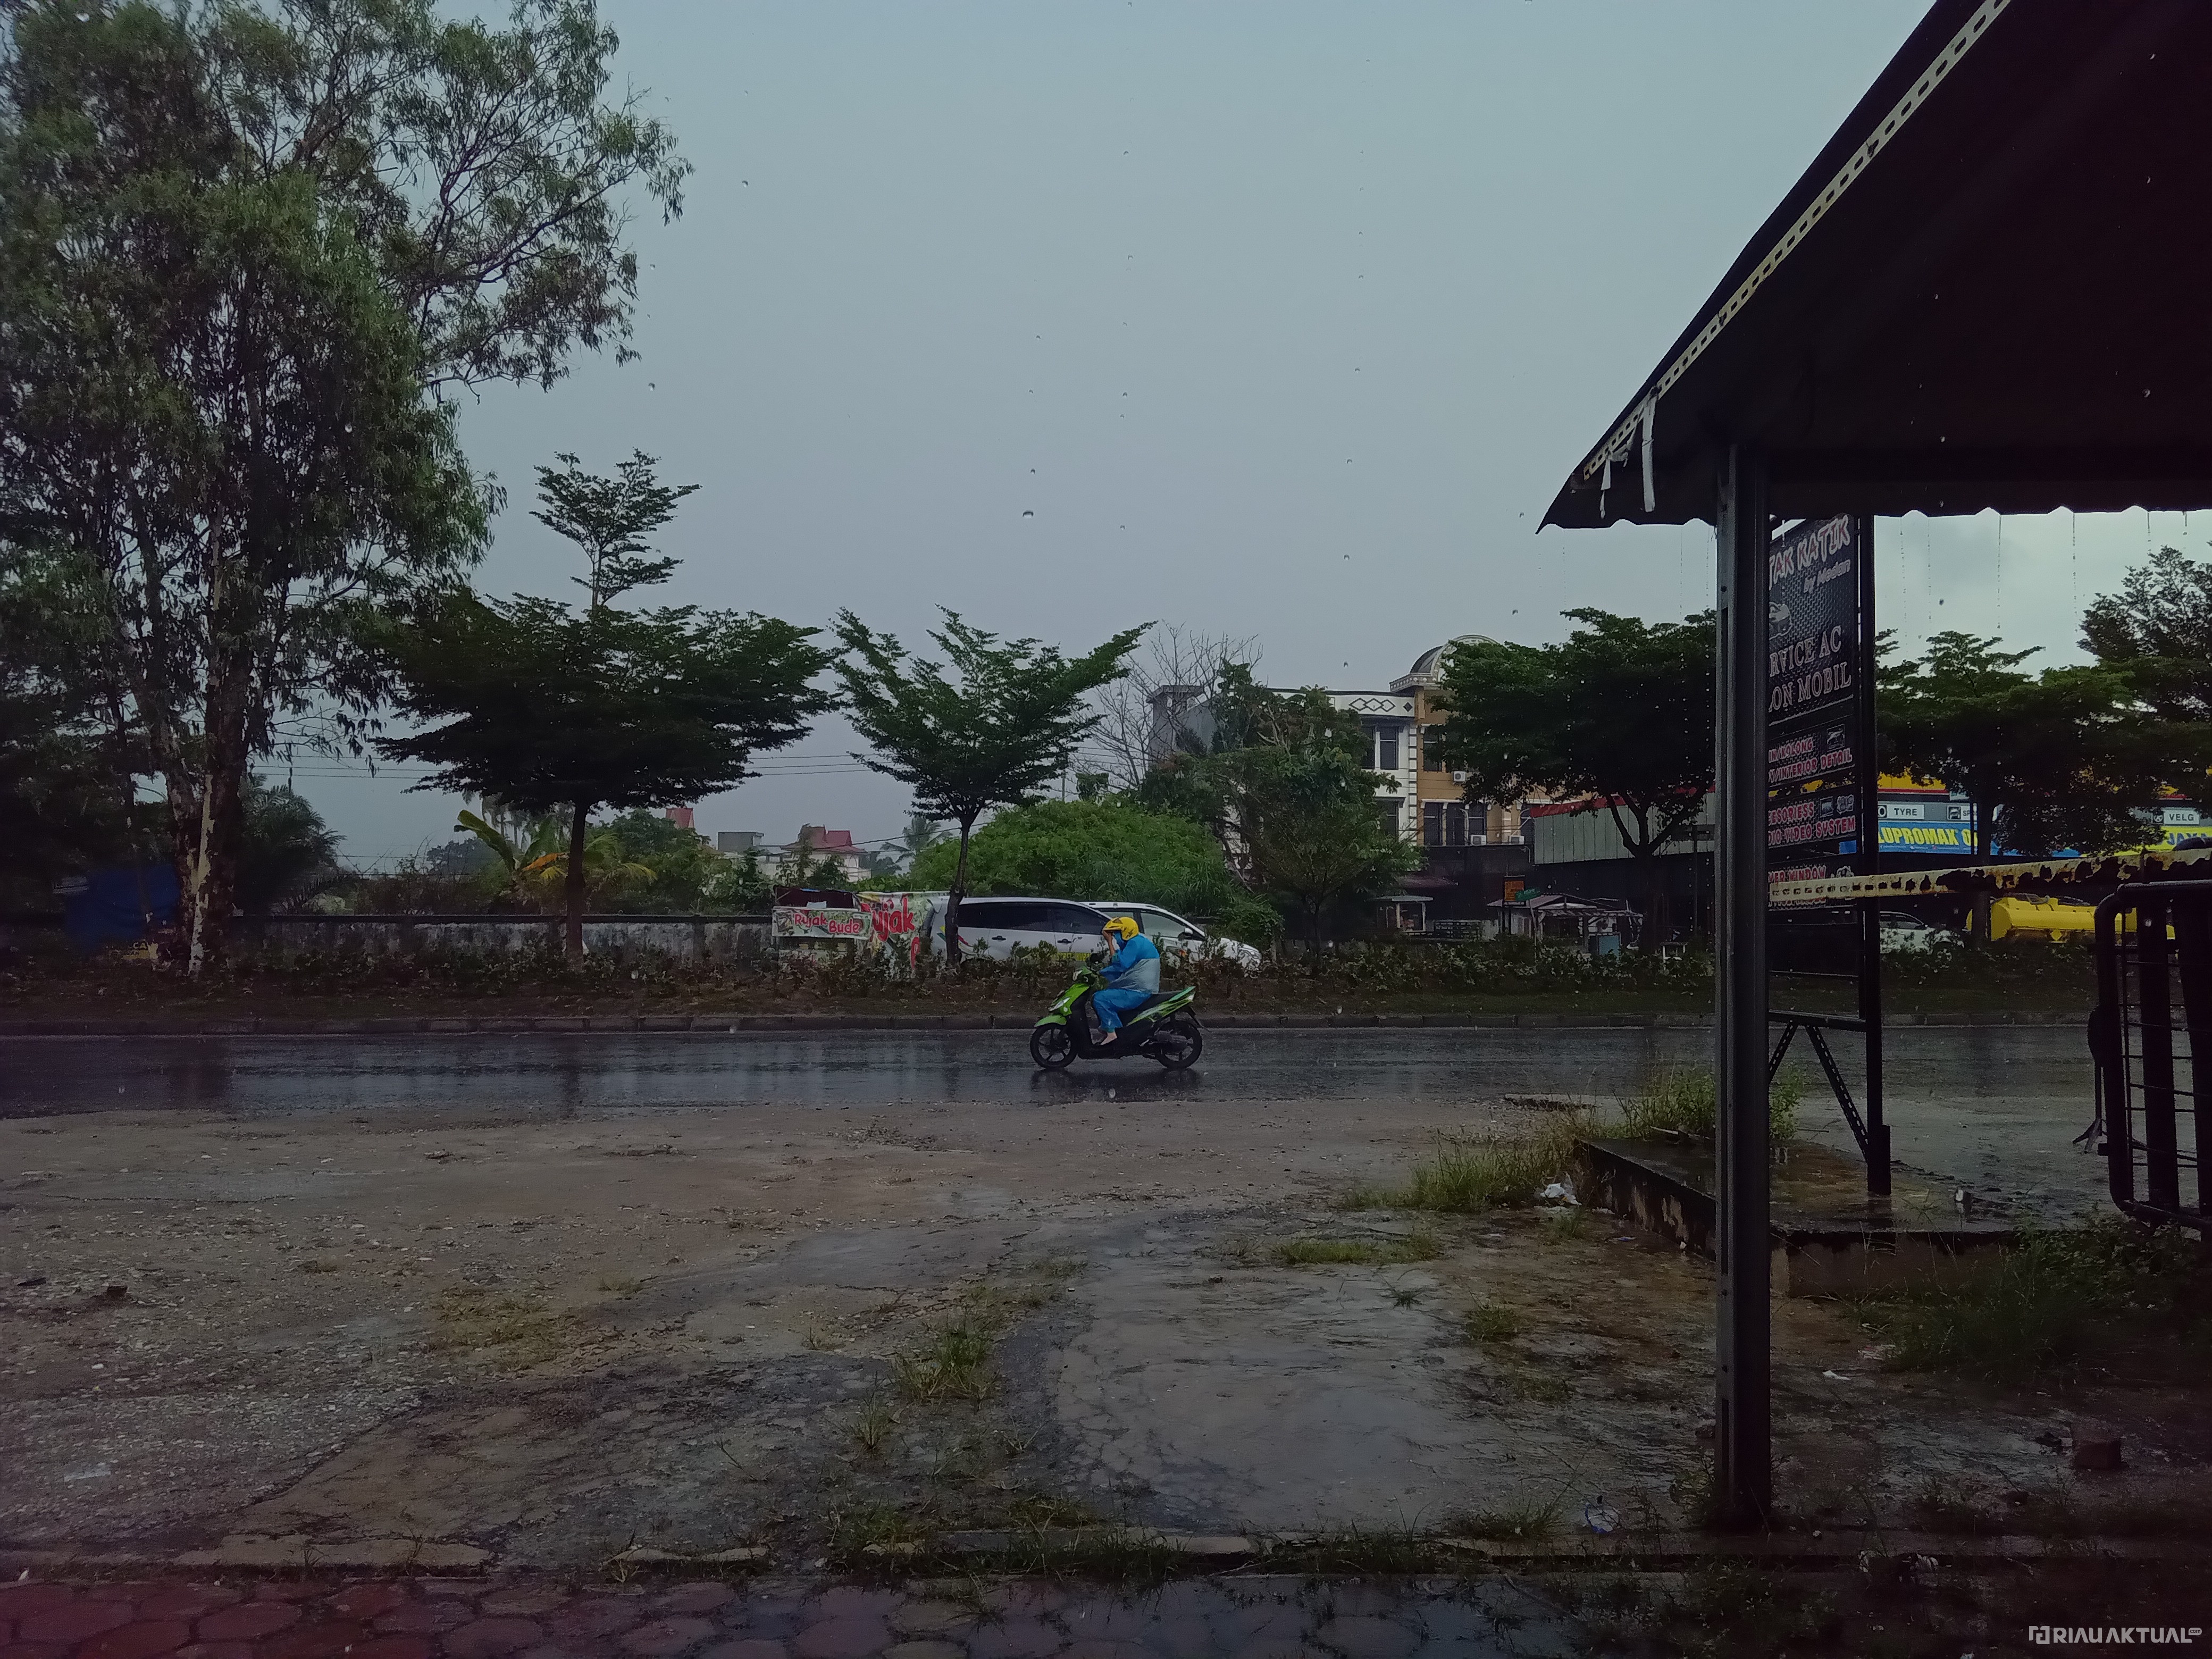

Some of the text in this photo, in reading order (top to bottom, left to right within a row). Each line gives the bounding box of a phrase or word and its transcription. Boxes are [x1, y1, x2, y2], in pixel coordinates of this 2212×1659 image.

[1797, 514, 1850, 571] KATIK
[1816, 559, 1851, 586] Medan
[1819, 625, 1841, 658] AC
[1797, 661, 1852, 703] MOBIL
[1820, 747, 1853, 770] DETAIL
[1893, 808, 1917, 816] TYRE
[1815, 815, 1856, 839] SYSTEM
[1788, 865, 1826, 882] WINDOW
[793, 911, 828, 928] Rujak
[828, 918, 860, 934] Bude
